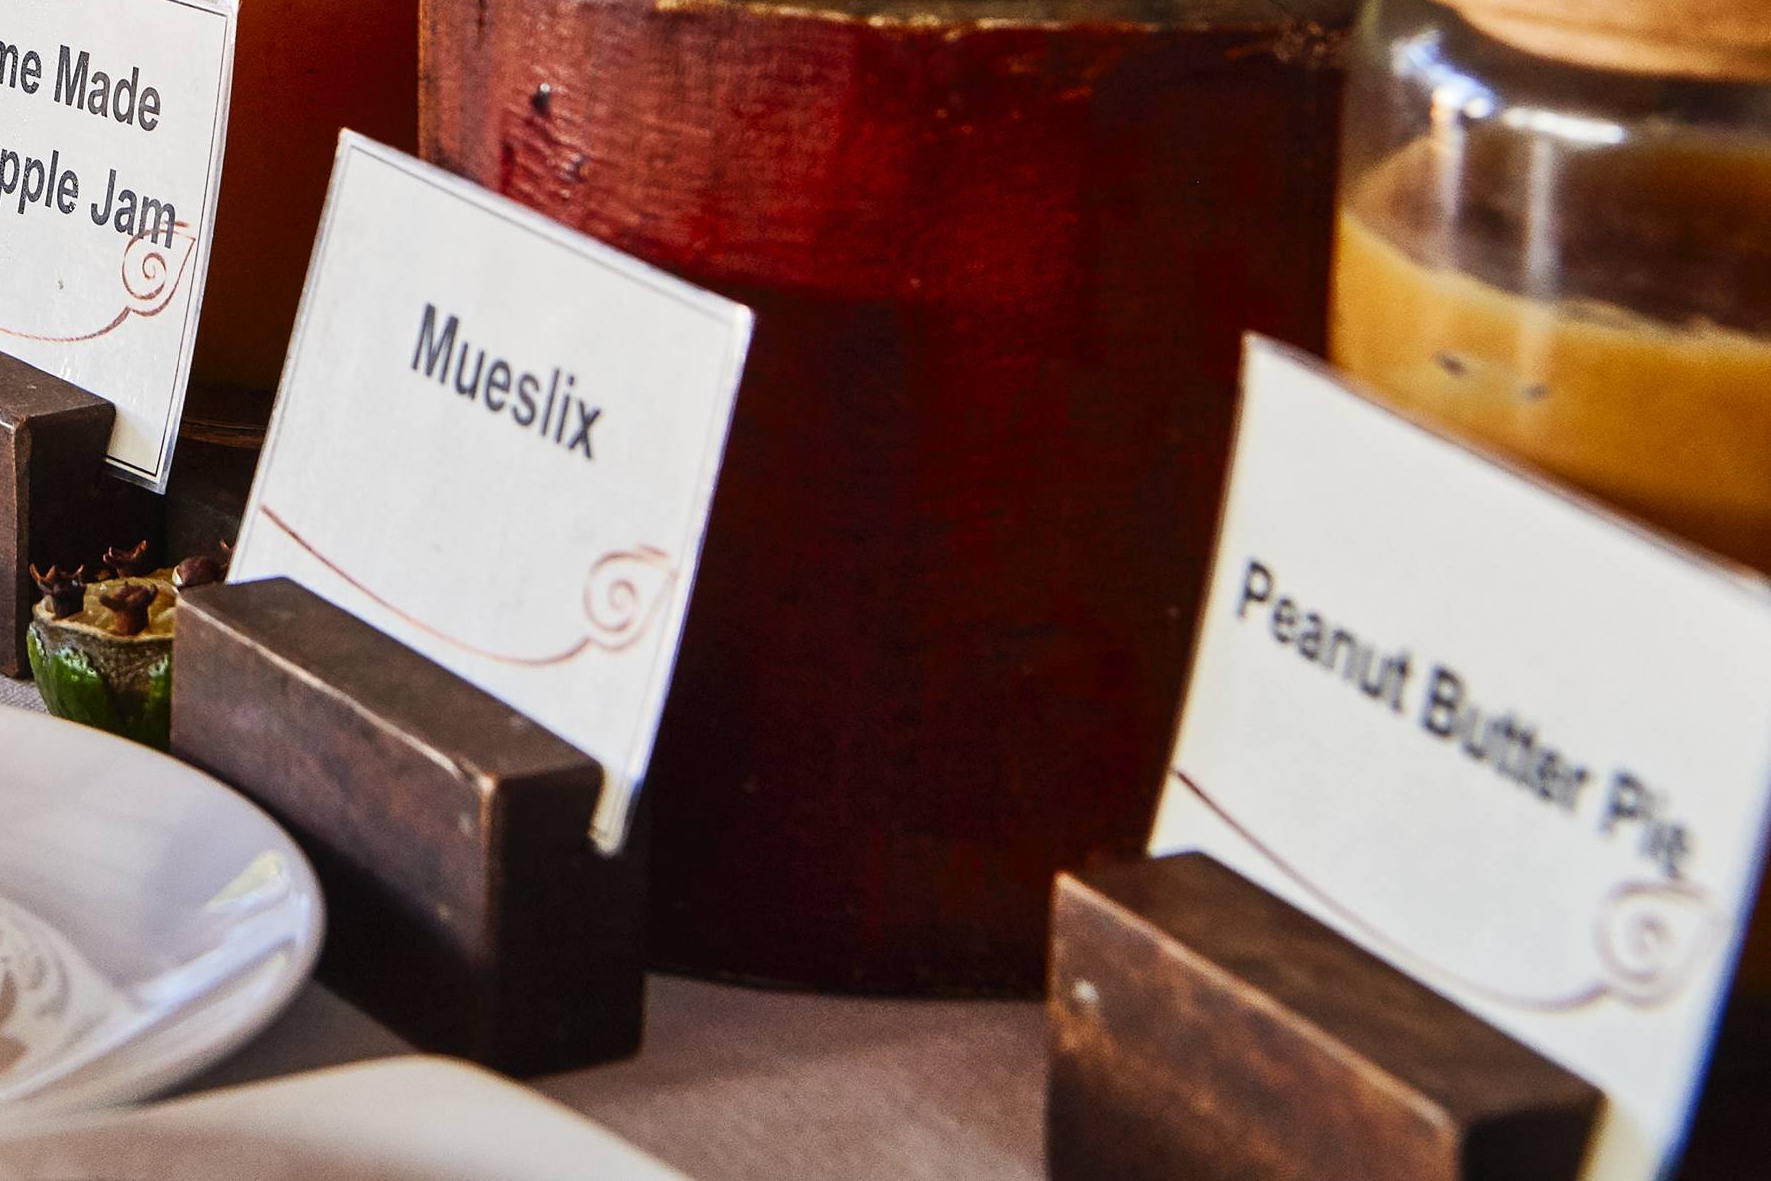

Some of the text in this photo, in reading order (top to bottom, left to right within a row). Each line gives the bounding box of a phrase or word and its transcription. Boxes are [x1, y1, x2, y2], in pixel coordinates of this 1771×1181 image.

[53, 44, 162, 132] Made
[90, 168, 176, 249] Jam
[411, 302, 602, 460] Mueslix
[1236, 557, 1411, 713] Peanut
[1419, 663, 1590, 813] Butter
